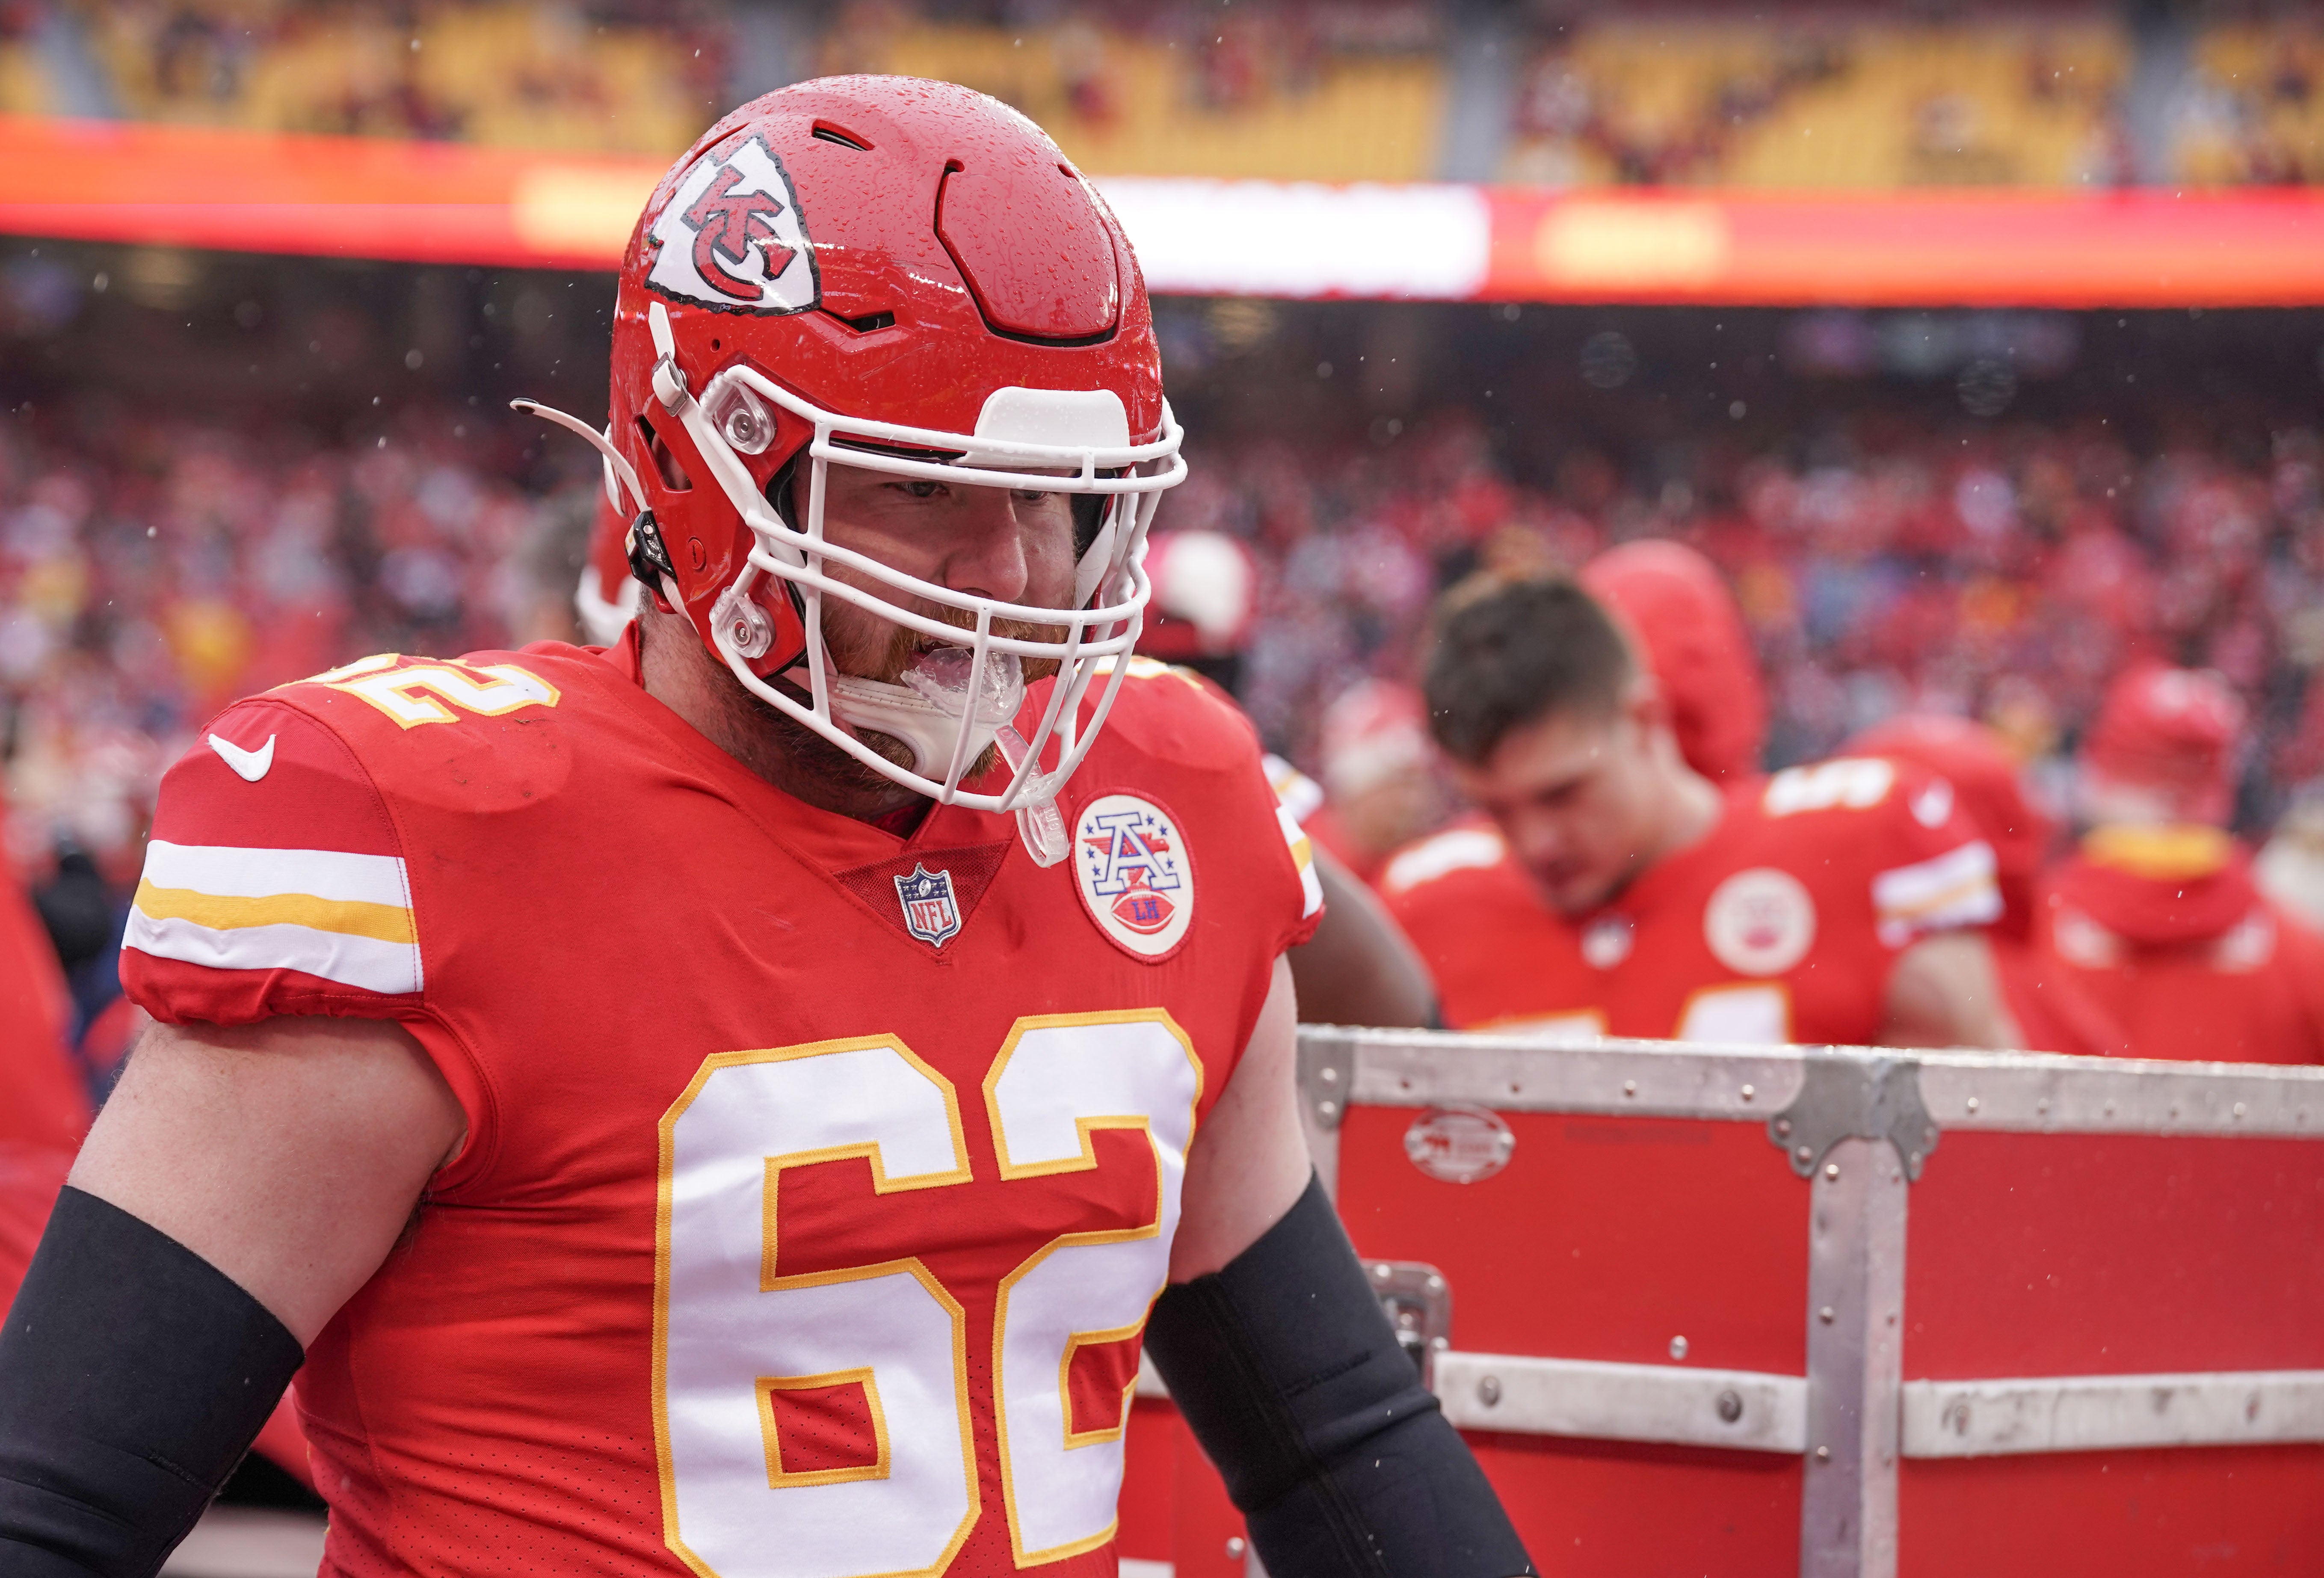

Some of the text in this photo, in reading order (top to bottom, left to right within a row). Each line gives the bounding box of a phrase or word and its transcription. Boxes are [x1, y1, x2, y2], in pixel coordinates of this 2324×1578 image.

[680, 164, 798, 301] KC
[1092, 812, 1181, 896] A
[911, 900, 953, 932] NFL
[1131, 900, 1160, 920] LH
[651, 1006, 1204, 1578] 62
